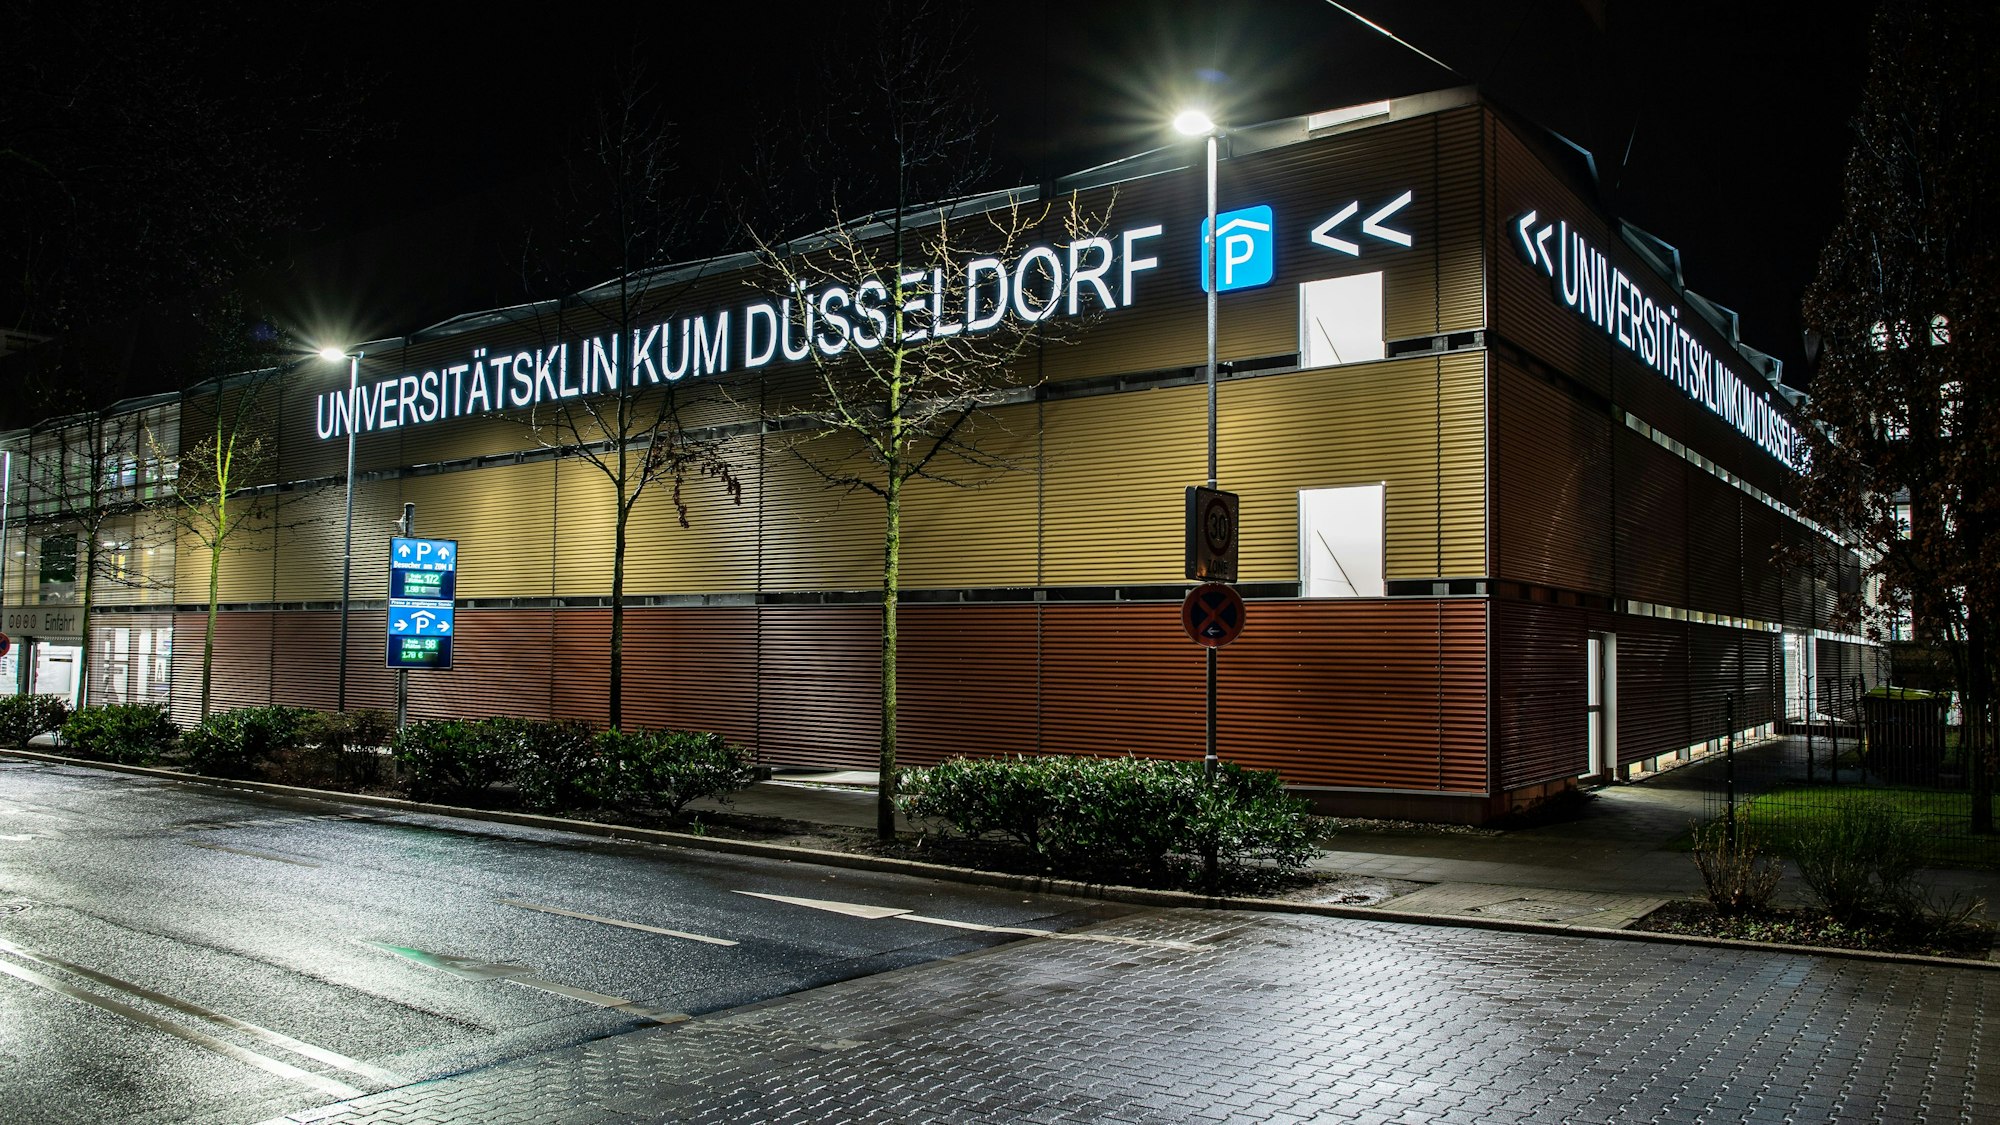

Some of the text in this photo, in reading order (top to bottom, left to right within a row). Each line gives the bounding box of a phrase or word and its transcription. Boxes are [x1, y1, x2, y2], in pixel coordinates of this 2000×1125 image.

[1224, 234, 1255, 285] P
[316, 224, 1163, 440] UNIVERSITÄTSKLINKUM DÜSSELDORF
[1560, 220, 1813, 477] UNIVERSITÄTSKLINIKUM DÜSSEL
[1209, 513, 1227, 540] 30
[416, 542, 432, 562] P
[45, 613, 75, 631] Einfahrt
[416, 618, 430, 634] P
[425, 640, 437, 649] 98
